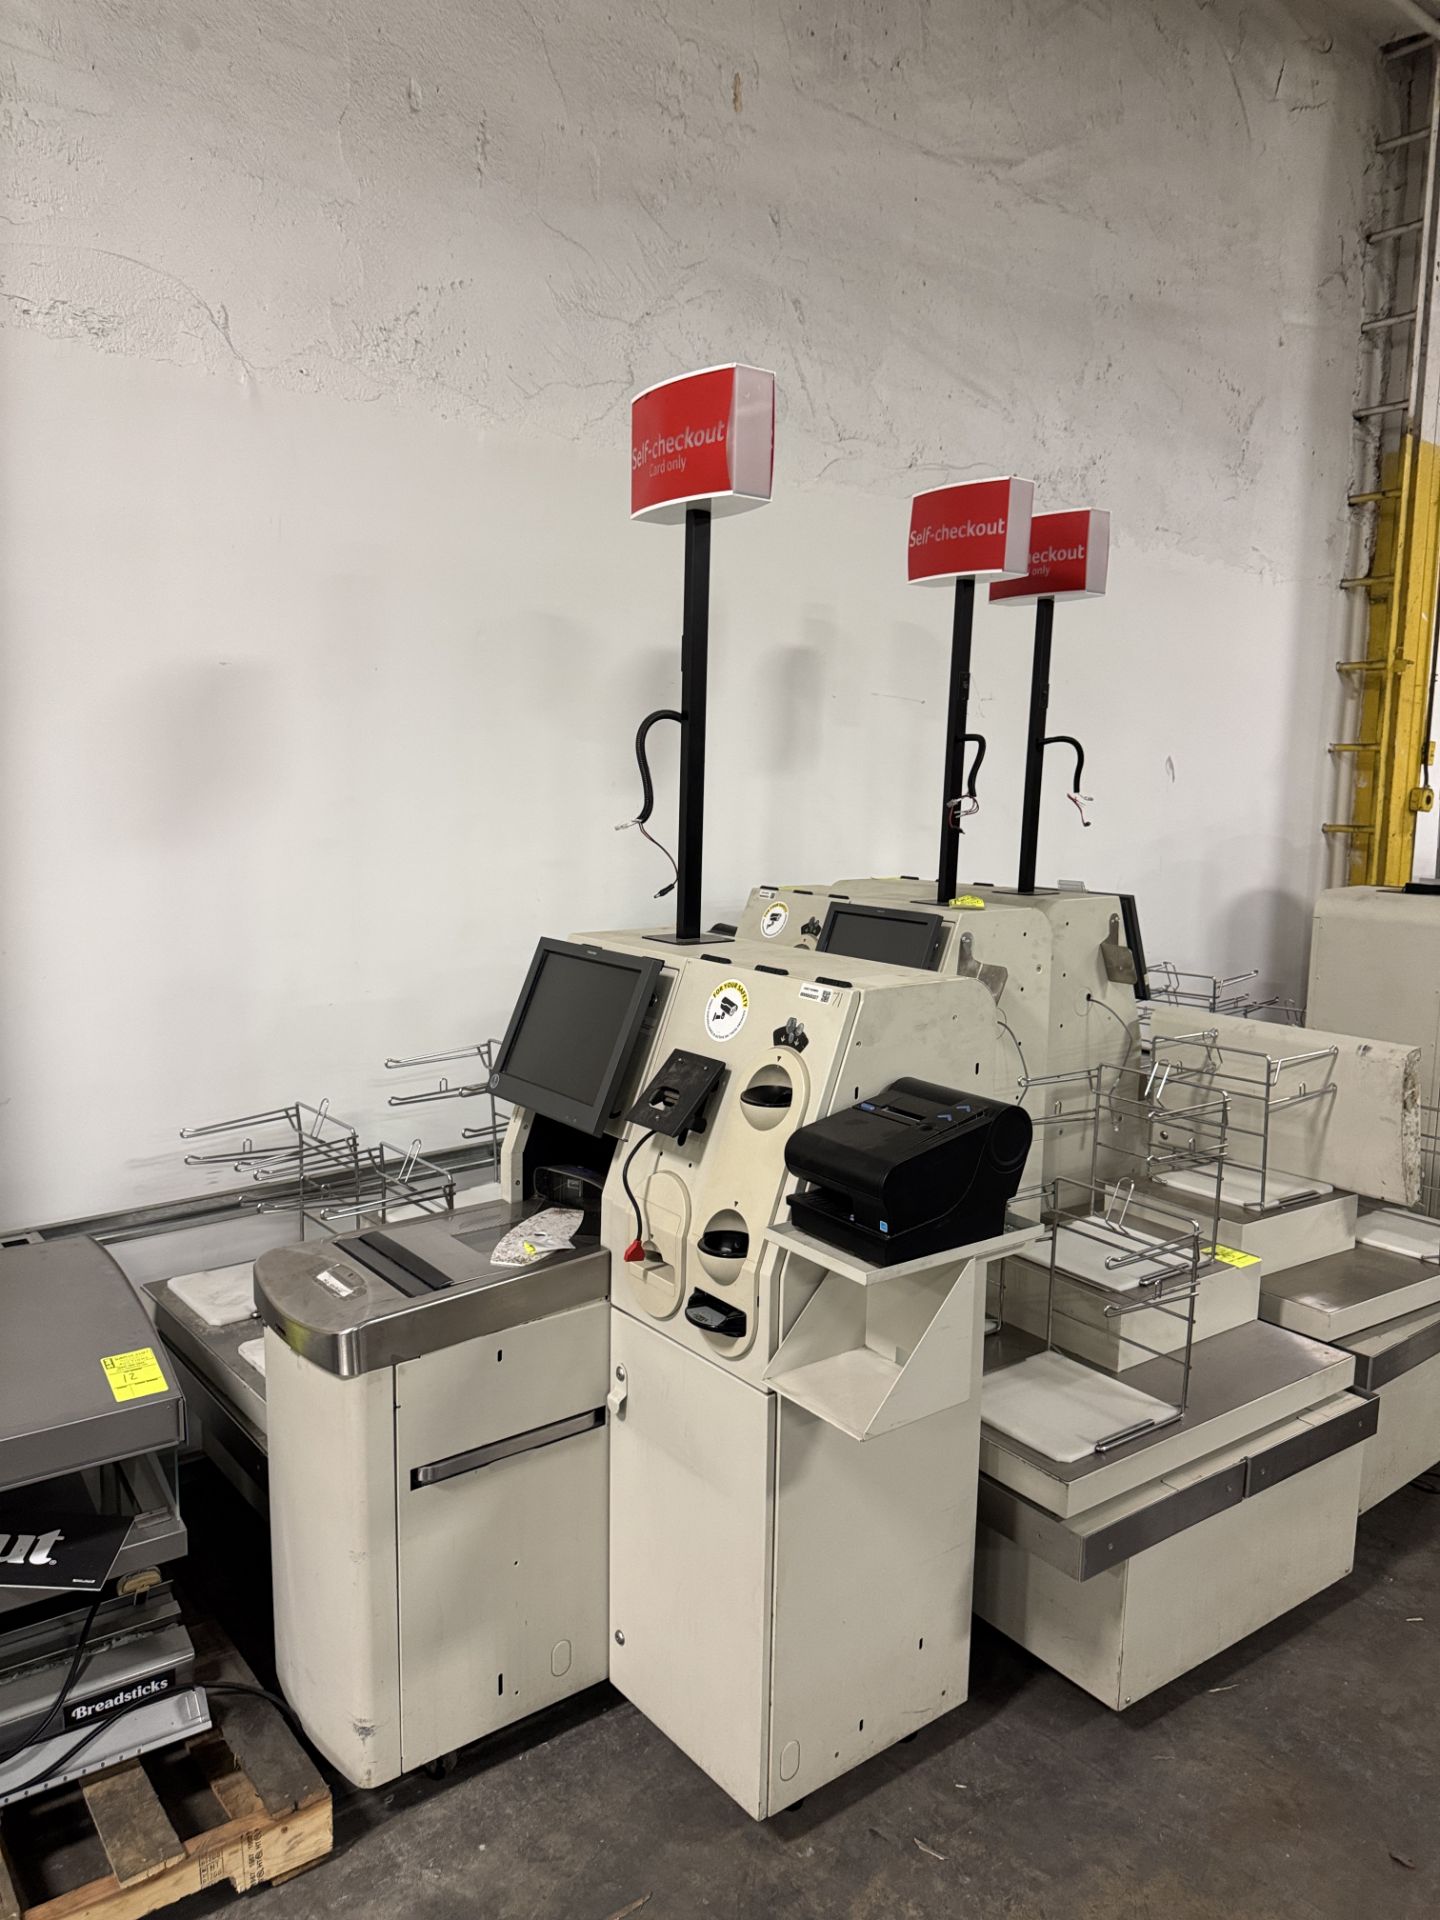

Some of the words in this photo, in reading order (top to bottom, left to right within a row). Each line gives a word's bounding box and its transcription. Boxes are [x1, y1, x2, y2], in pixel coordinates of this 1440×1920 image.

[632, 420, 725, 470] Self-checkout
[649, 459, 666, 477] Card
[667, 455, 687, 472] only
[909, 517, 1005, 547] Self-checkout
[1032, 564, 1050, 577] only
[712, 985, 723, 998] FOR
[737, 984, 748, 1007] SAFETY
[71, 1679, 169, 1720] Breadsticks
